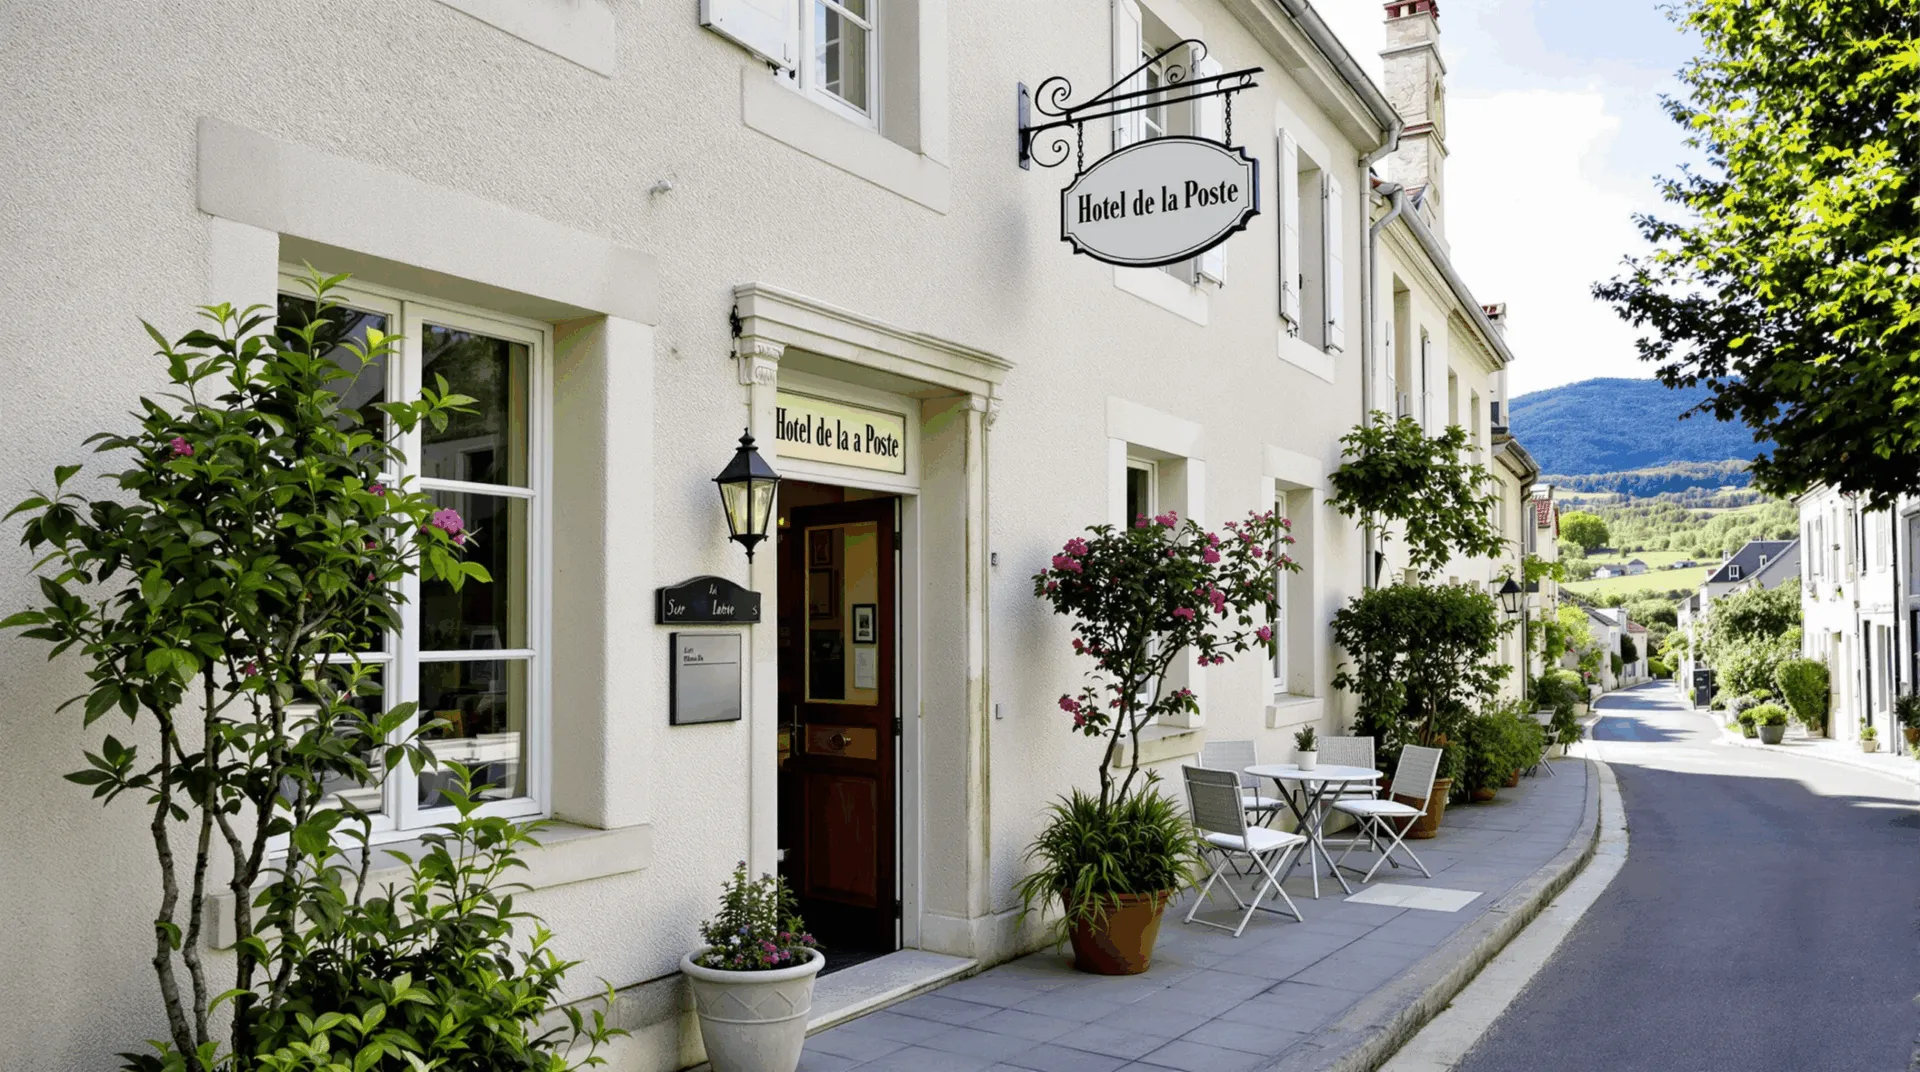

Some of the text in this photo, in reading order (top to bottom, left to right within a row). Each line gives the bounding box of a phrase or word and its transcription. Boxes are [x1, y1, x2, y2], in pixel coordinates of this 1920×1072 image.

[1078, 180, 1239, 224] Hotel de la Poste
[776, 407, 899, 458] Hotel de la a Poste
